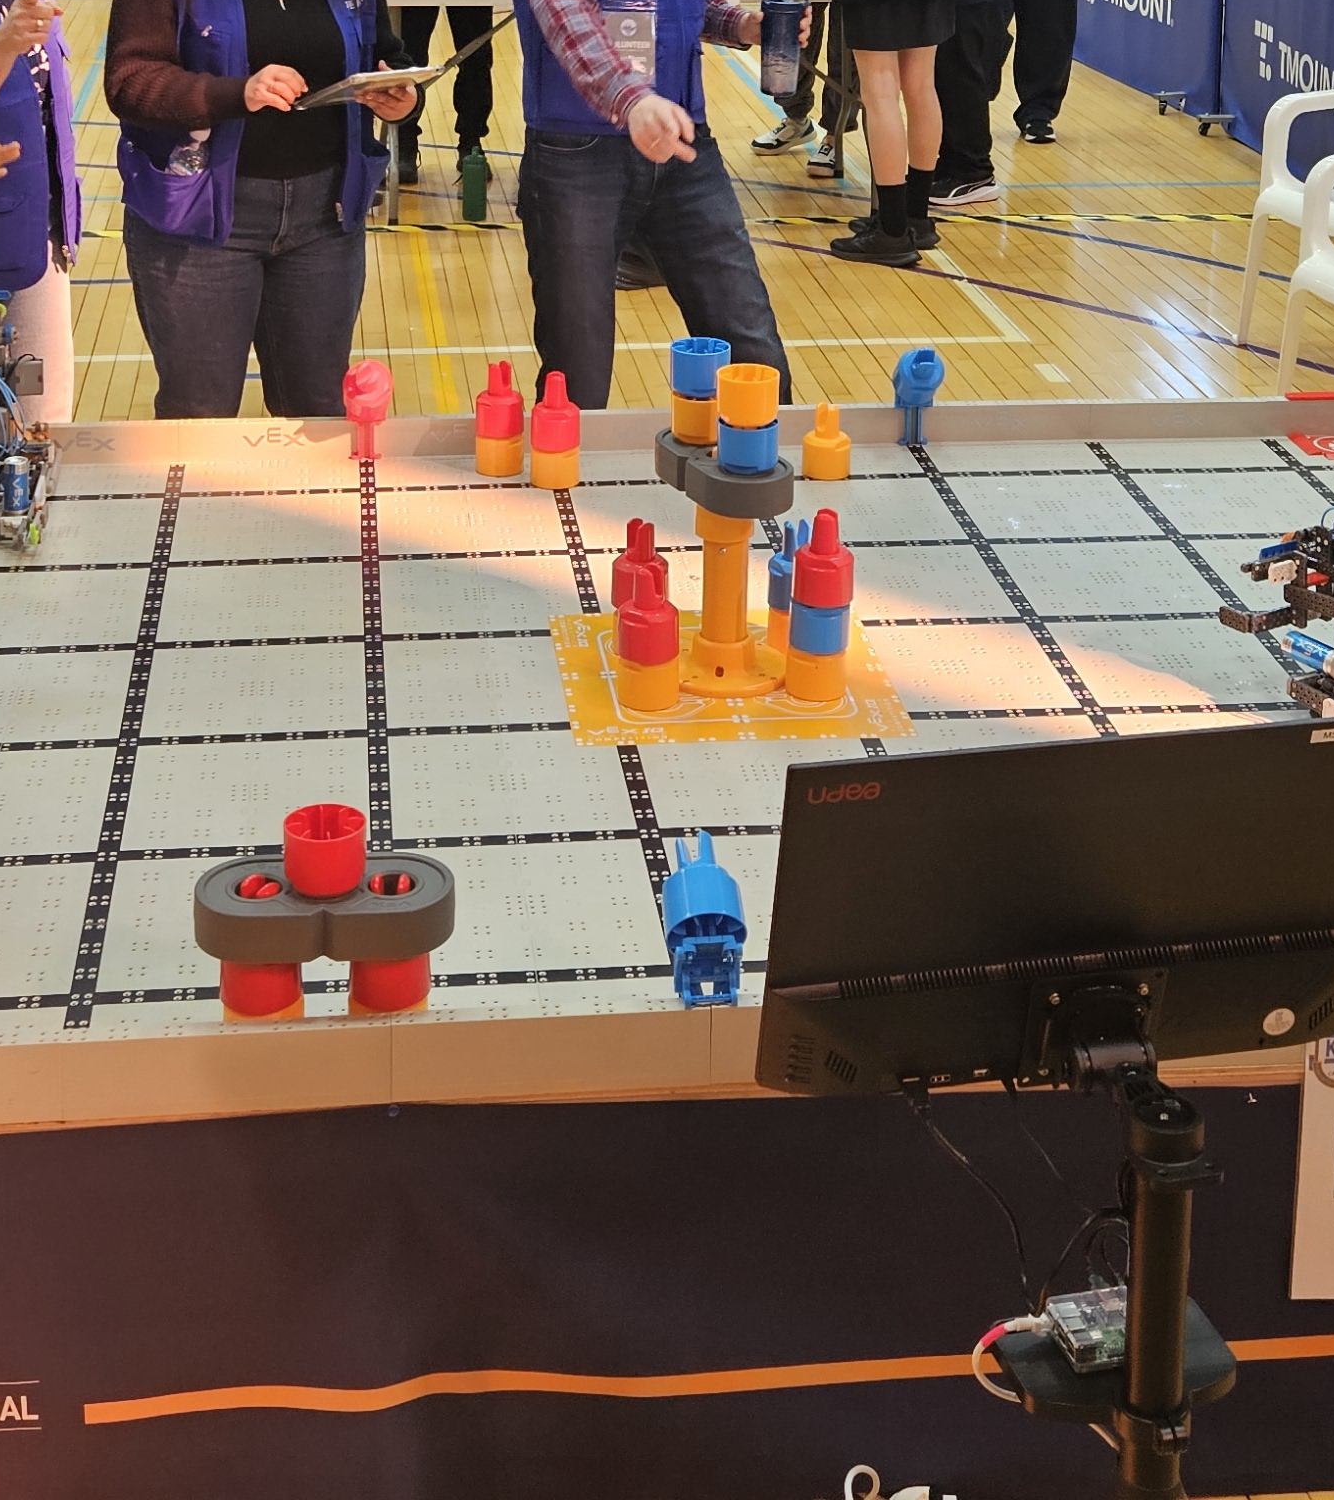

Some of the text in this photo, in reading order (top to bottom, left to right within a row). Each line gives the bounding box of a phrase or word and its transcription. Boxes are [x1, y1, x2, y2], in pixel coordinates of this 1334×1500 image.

[242, 426, 306, 448] VEX
[11, 476, 30, 510] VEX
[587, 726, 642, 736] VEX
